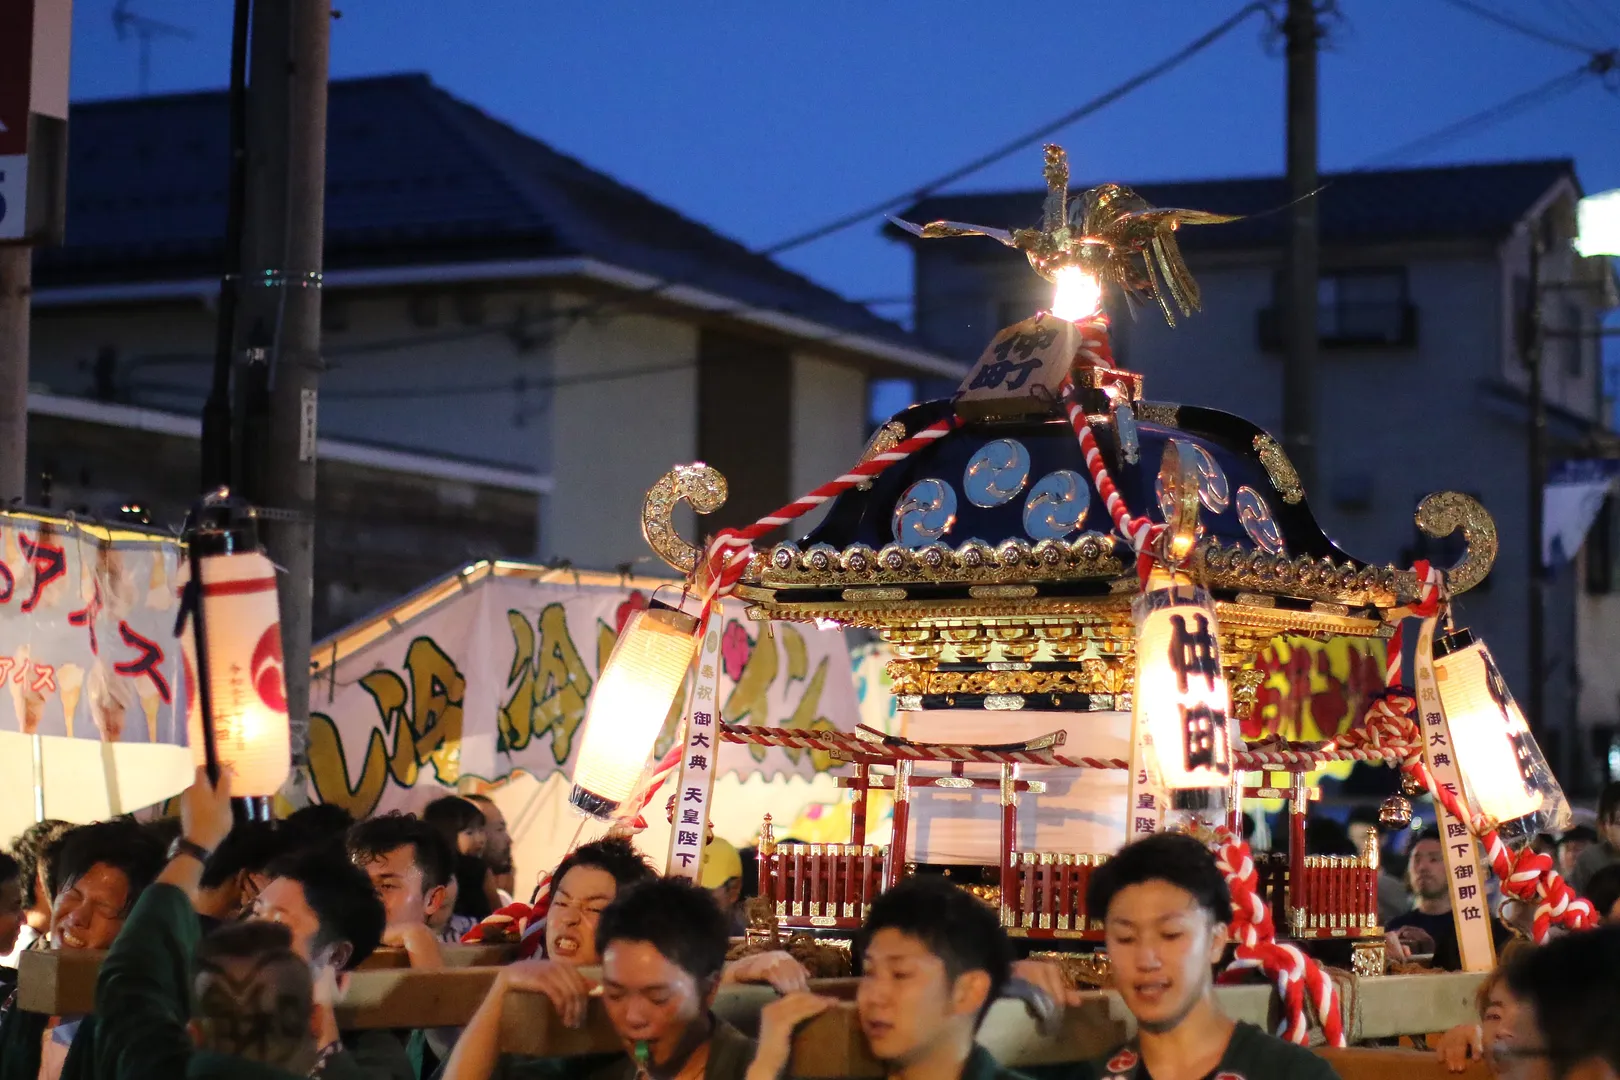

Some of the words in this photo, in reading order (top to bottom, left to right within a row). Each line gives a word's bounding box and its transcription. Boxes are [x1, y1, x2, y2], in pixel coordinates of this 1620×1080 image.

[688, 711, 711, 770] 御大典
[1426, 712, 1451, 768] 御大典
